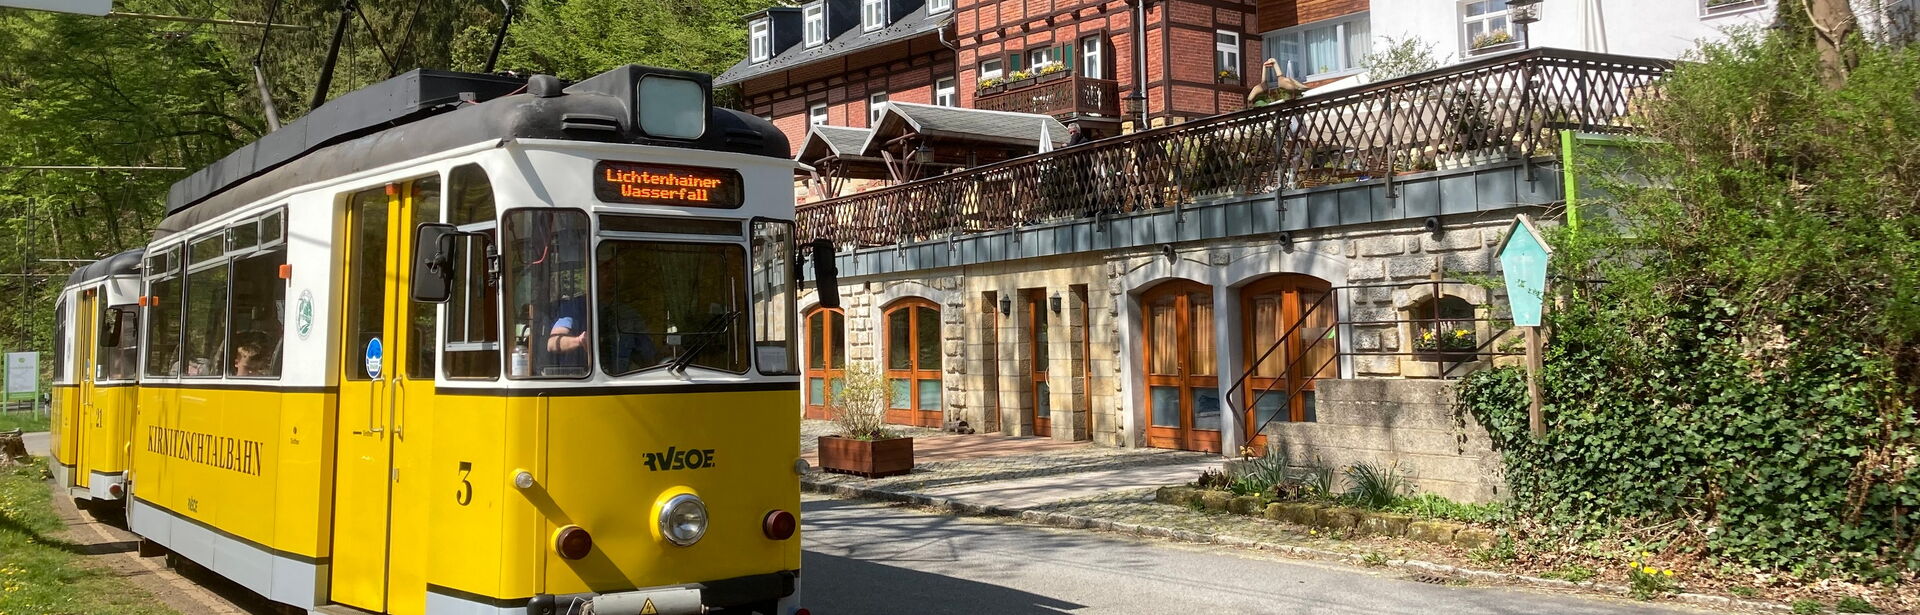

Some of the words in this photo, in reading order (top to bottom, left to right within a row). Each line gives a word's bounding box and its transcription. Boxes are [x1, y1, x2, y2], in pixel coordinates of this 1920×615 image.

[606, 168, 721, 188] Lichtenhainer
[621, 184, 708, 201] Wasserfall
[147, 425, 263, 477] KIRNITZSCHTALBAHN
[457, 461, 472, 506] 3
